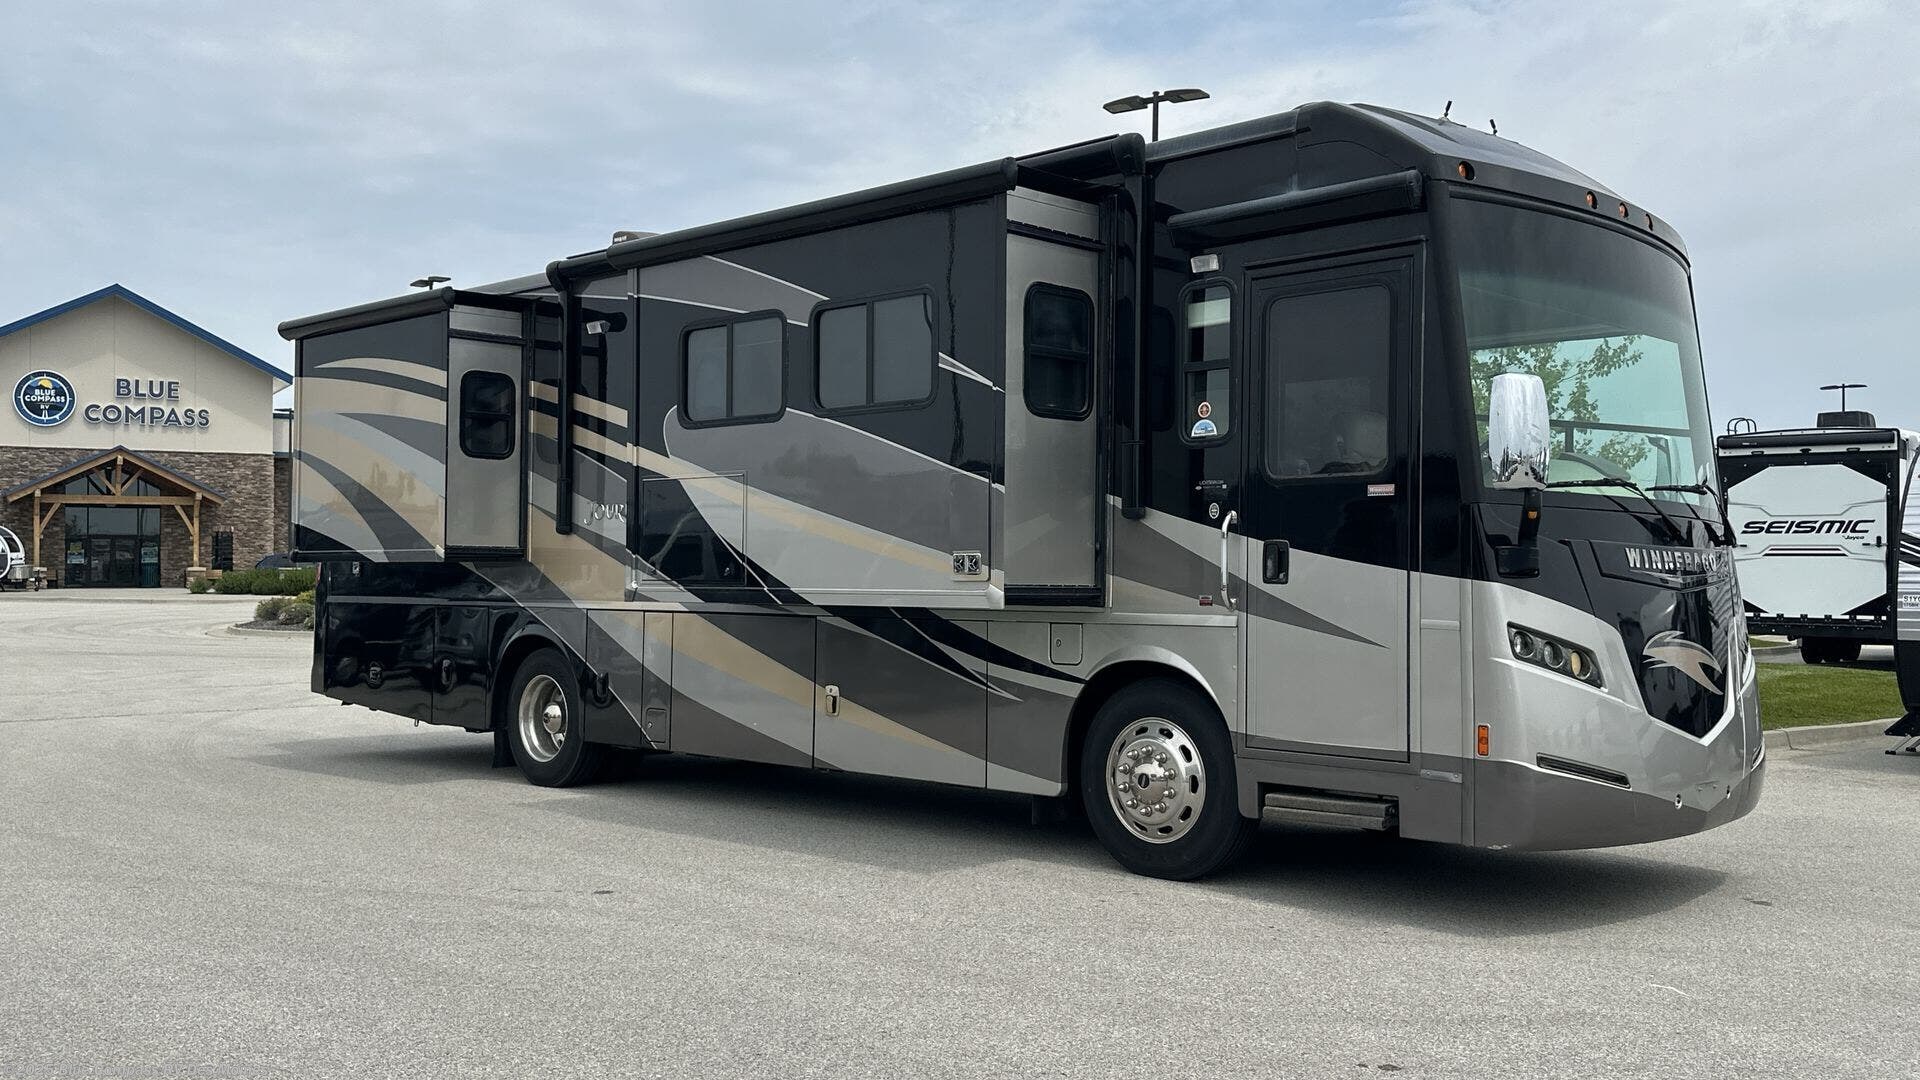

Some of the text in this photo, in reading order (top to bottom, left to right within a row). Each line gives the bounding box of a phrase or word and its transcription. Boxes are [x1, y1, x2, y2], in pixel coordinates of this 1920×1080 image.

[25, 395, 66, 403] COMPASS
[34, 388, 56, 396] BLUE
[116, 378, 180, 399] BLUE
[84, 404, 210, 427] COMPASS
[583, 502, 627, 525] JOUR
[1740, 519, 1876, 535] SEISMIC
[1625, 547, 1717, 572] WINNEBAGO
